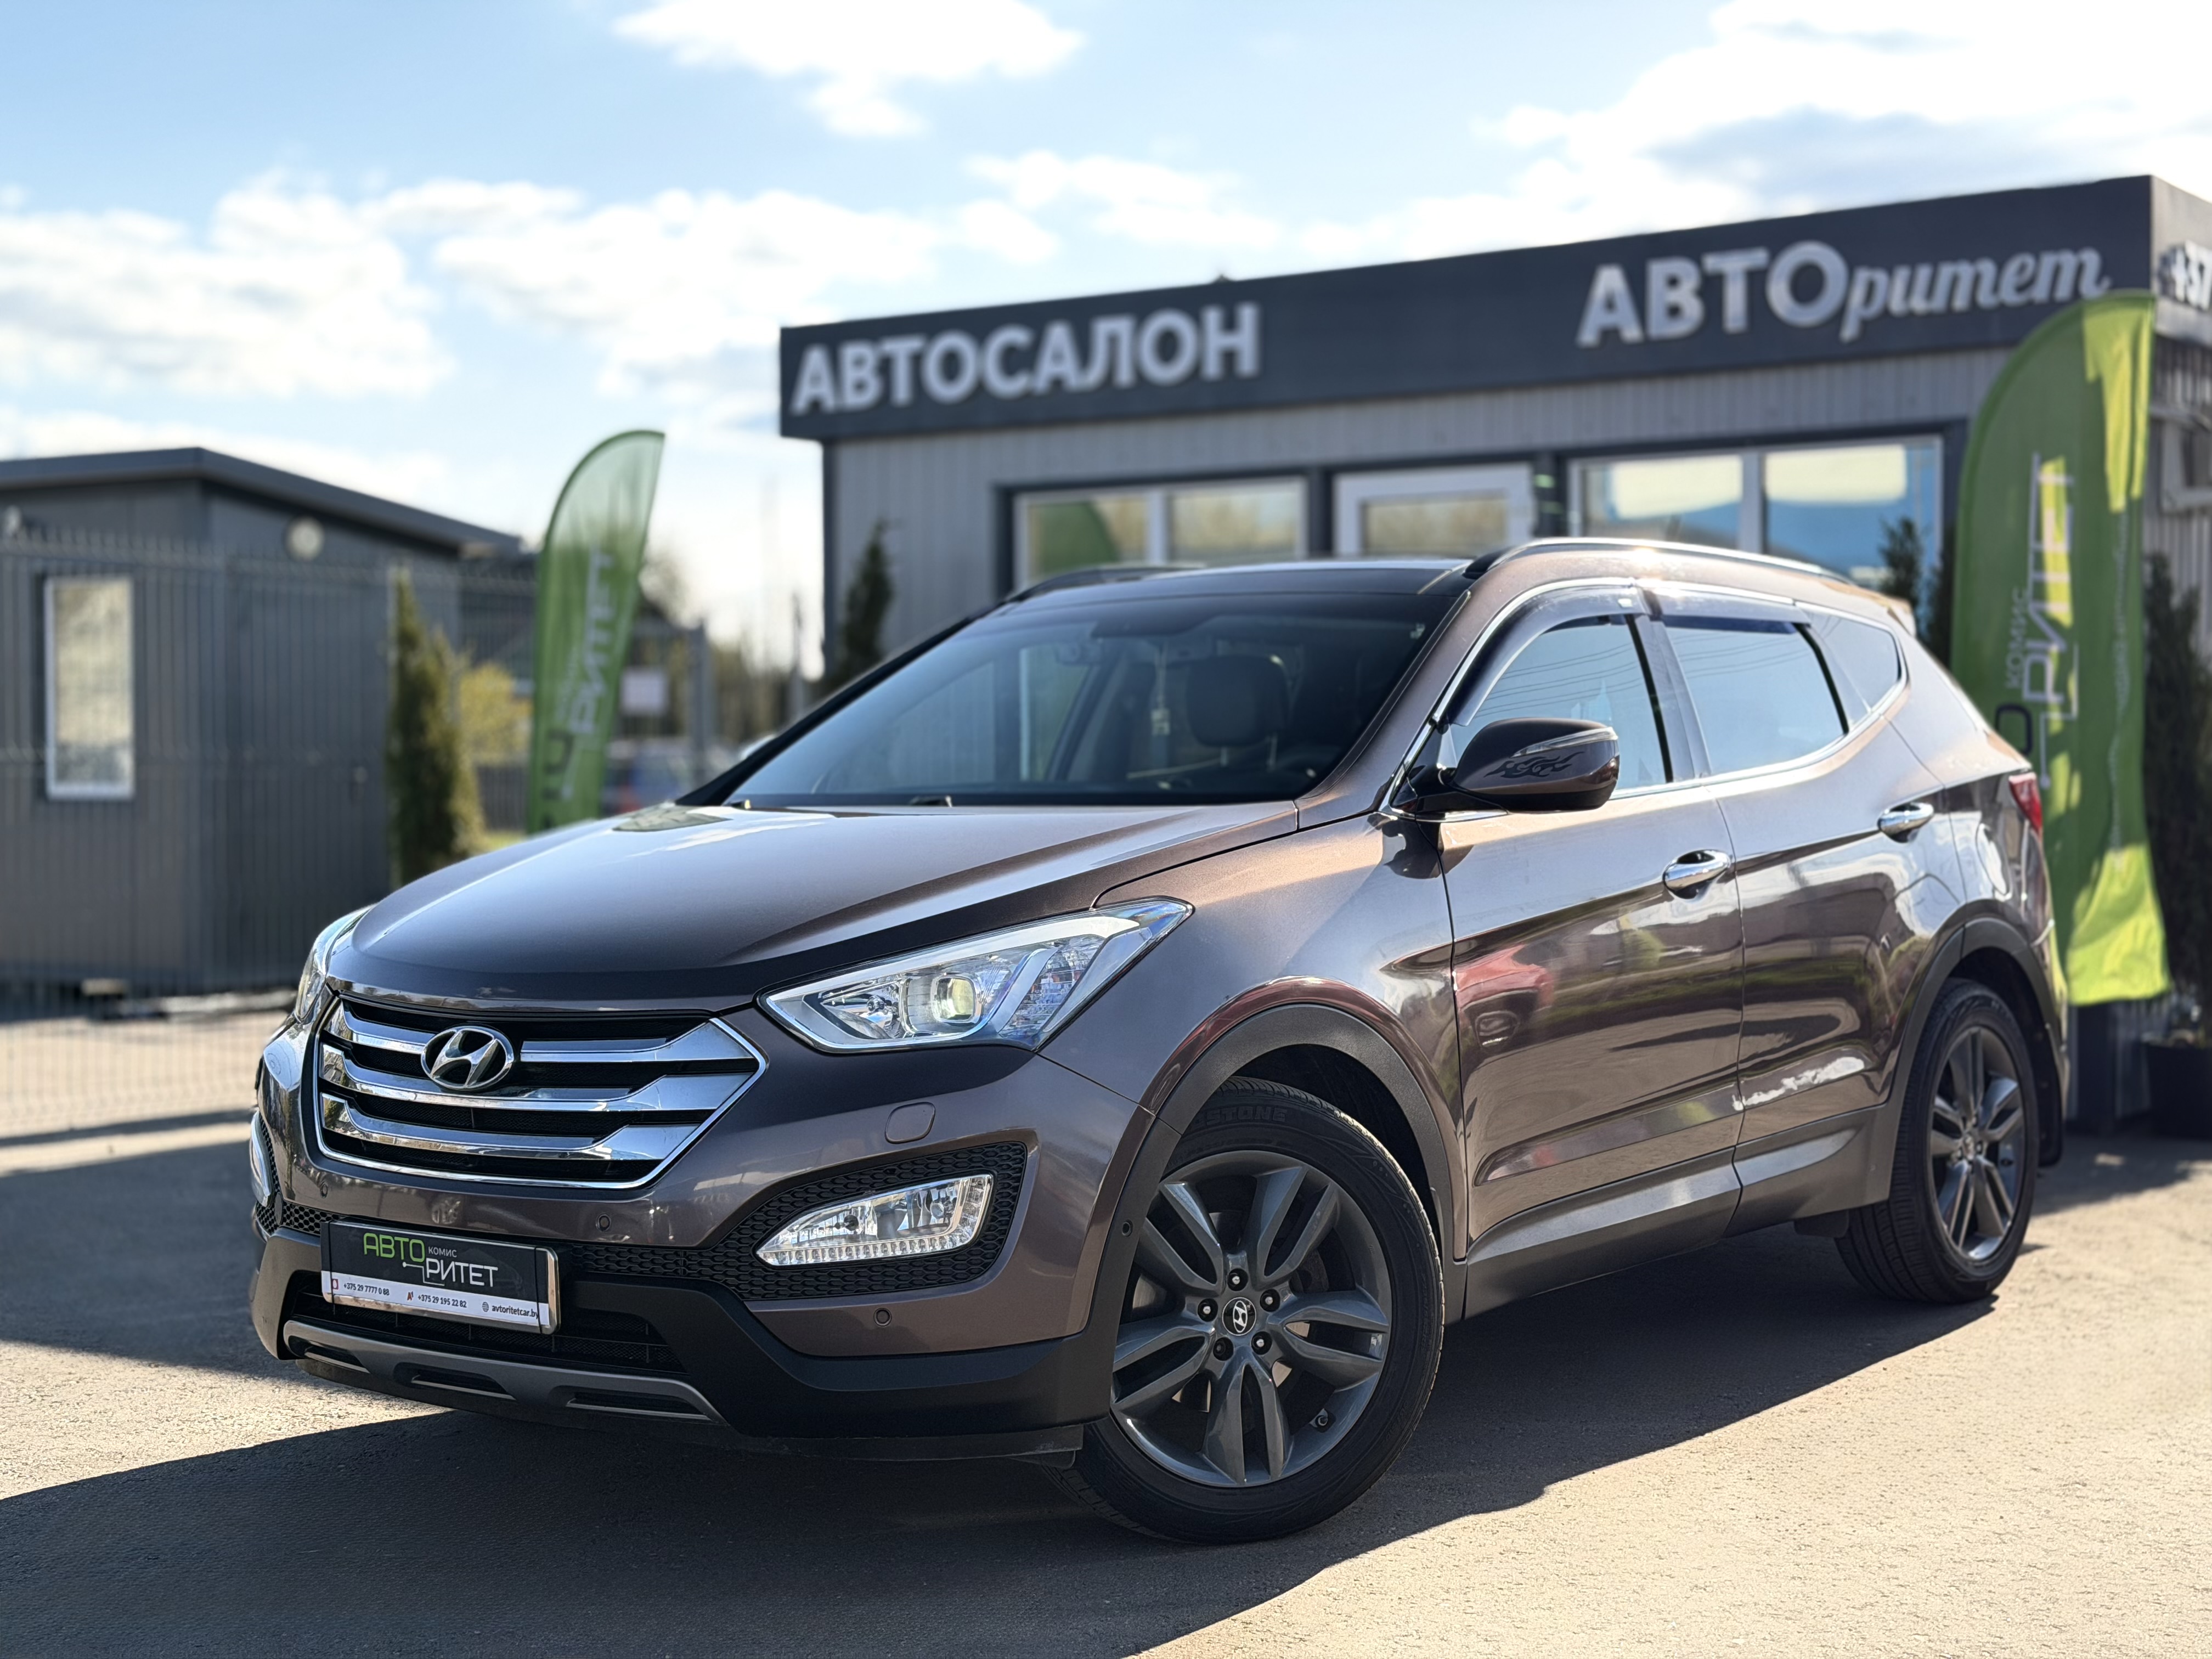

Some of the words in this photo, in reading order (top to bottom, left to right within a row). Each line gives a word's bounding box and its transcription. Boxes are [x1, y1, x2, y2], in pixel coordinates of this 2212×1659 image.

[791, 302, 1261, 416] АВТОСАЛОН
[2022, 454, 2074, 703] РИТЕТ
[363, 1233, 425, 1262] АВТО
[428, 1246, 457, 1257] КОМИС
[426, 1257, 498, 1287] РИТЕТ
[343, 1283, 356, 1291] +375
[417, 1294, 431, 1302] +375
[492, 1305, 538, 1319] avtoritetcar.by
